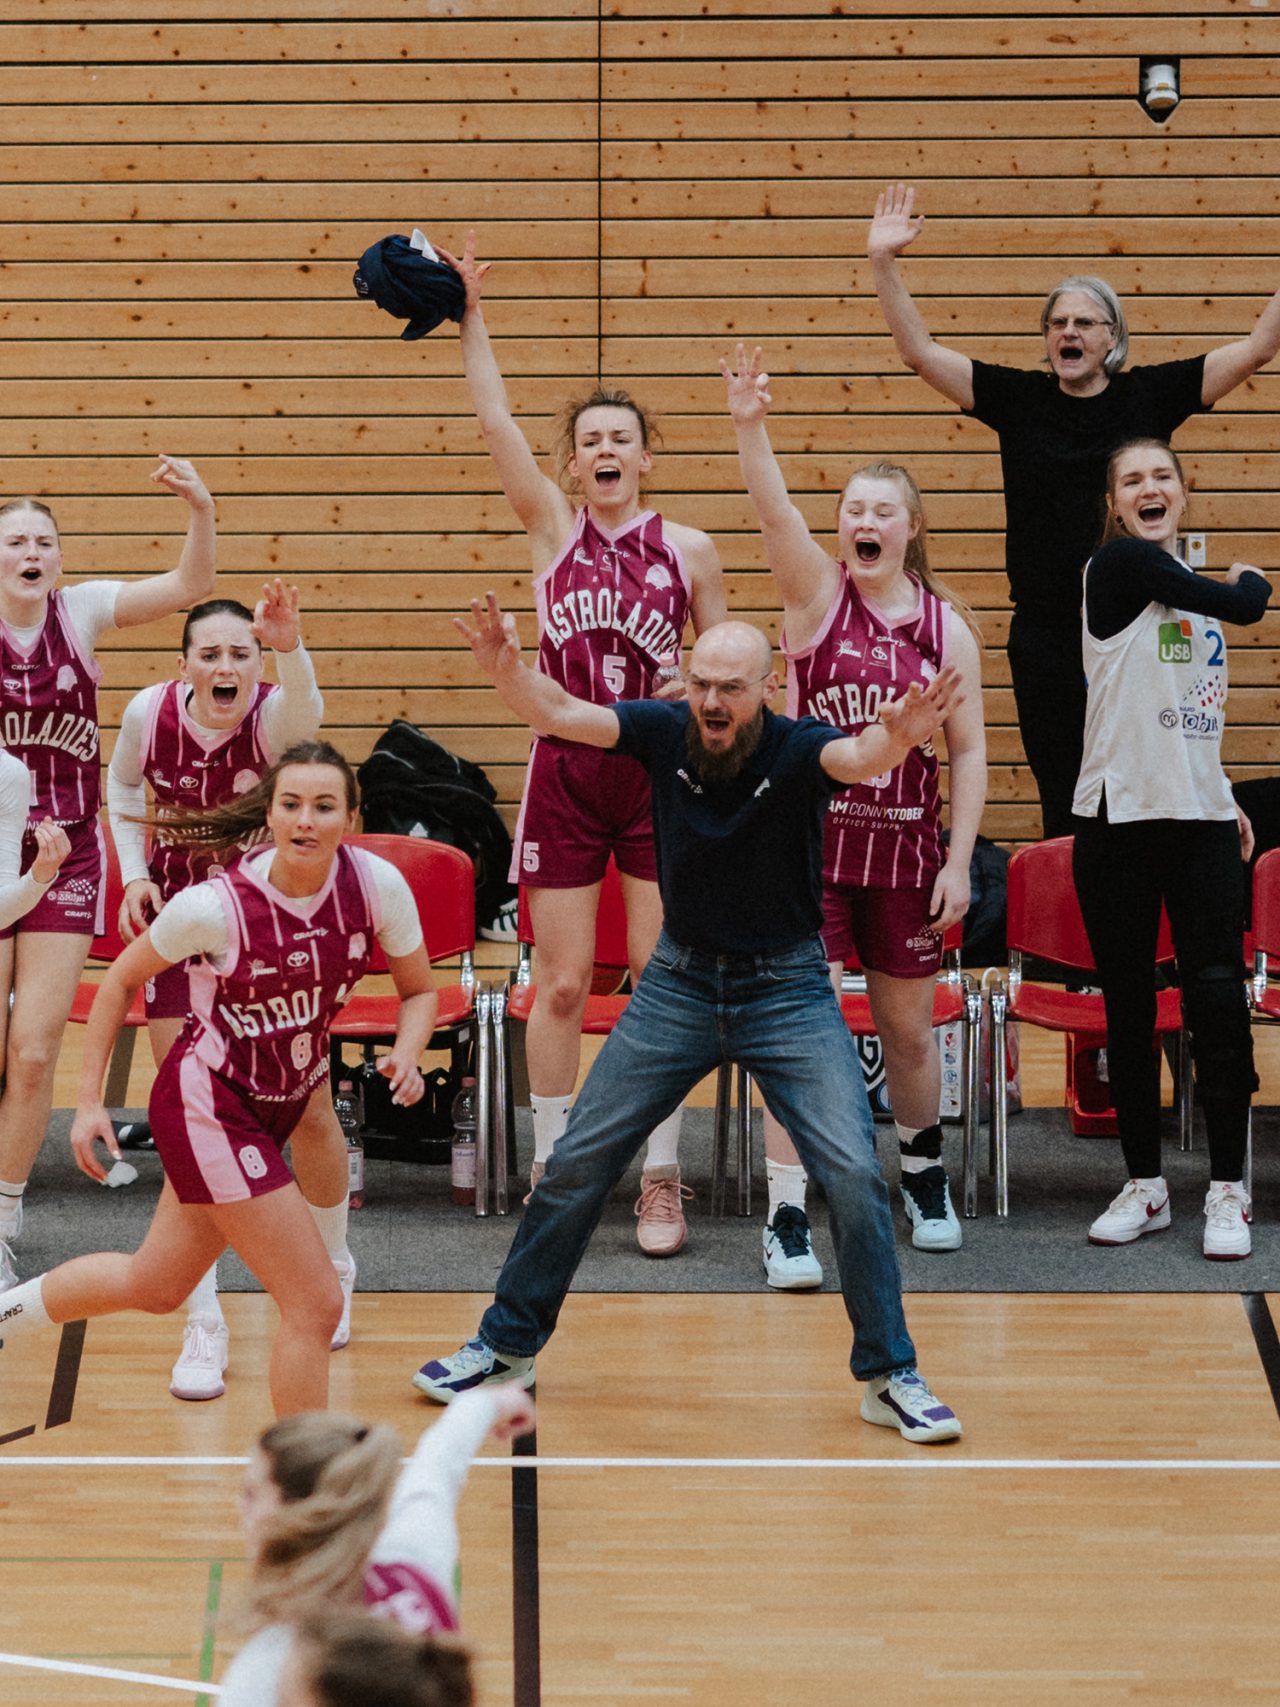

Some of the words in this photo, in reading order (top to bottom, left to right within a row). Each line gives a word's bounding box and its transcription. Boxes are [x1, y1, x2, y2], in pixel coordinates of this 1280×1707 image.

[544, 587, 678, 664] ASTROLADI
[1161, 644, 1191, 661] USB
[1204, 630, 1224, 667] 2
[602, 654, 627, 695] 5
[828, 800, 847, 814] AM
[849, 802, 889, 817] CONNY
[886, 808, 925, 821] STOBER
[523, 841, 540, 872] 5
[64, 910, 87, 918] CRAFT
[292, 930, 320, 940] CRAFT
[290, 1031, 313, 1071] 8
[238, 1144, 268, 1179] 8
[0, 1303, 24, 1323] CRAFT
